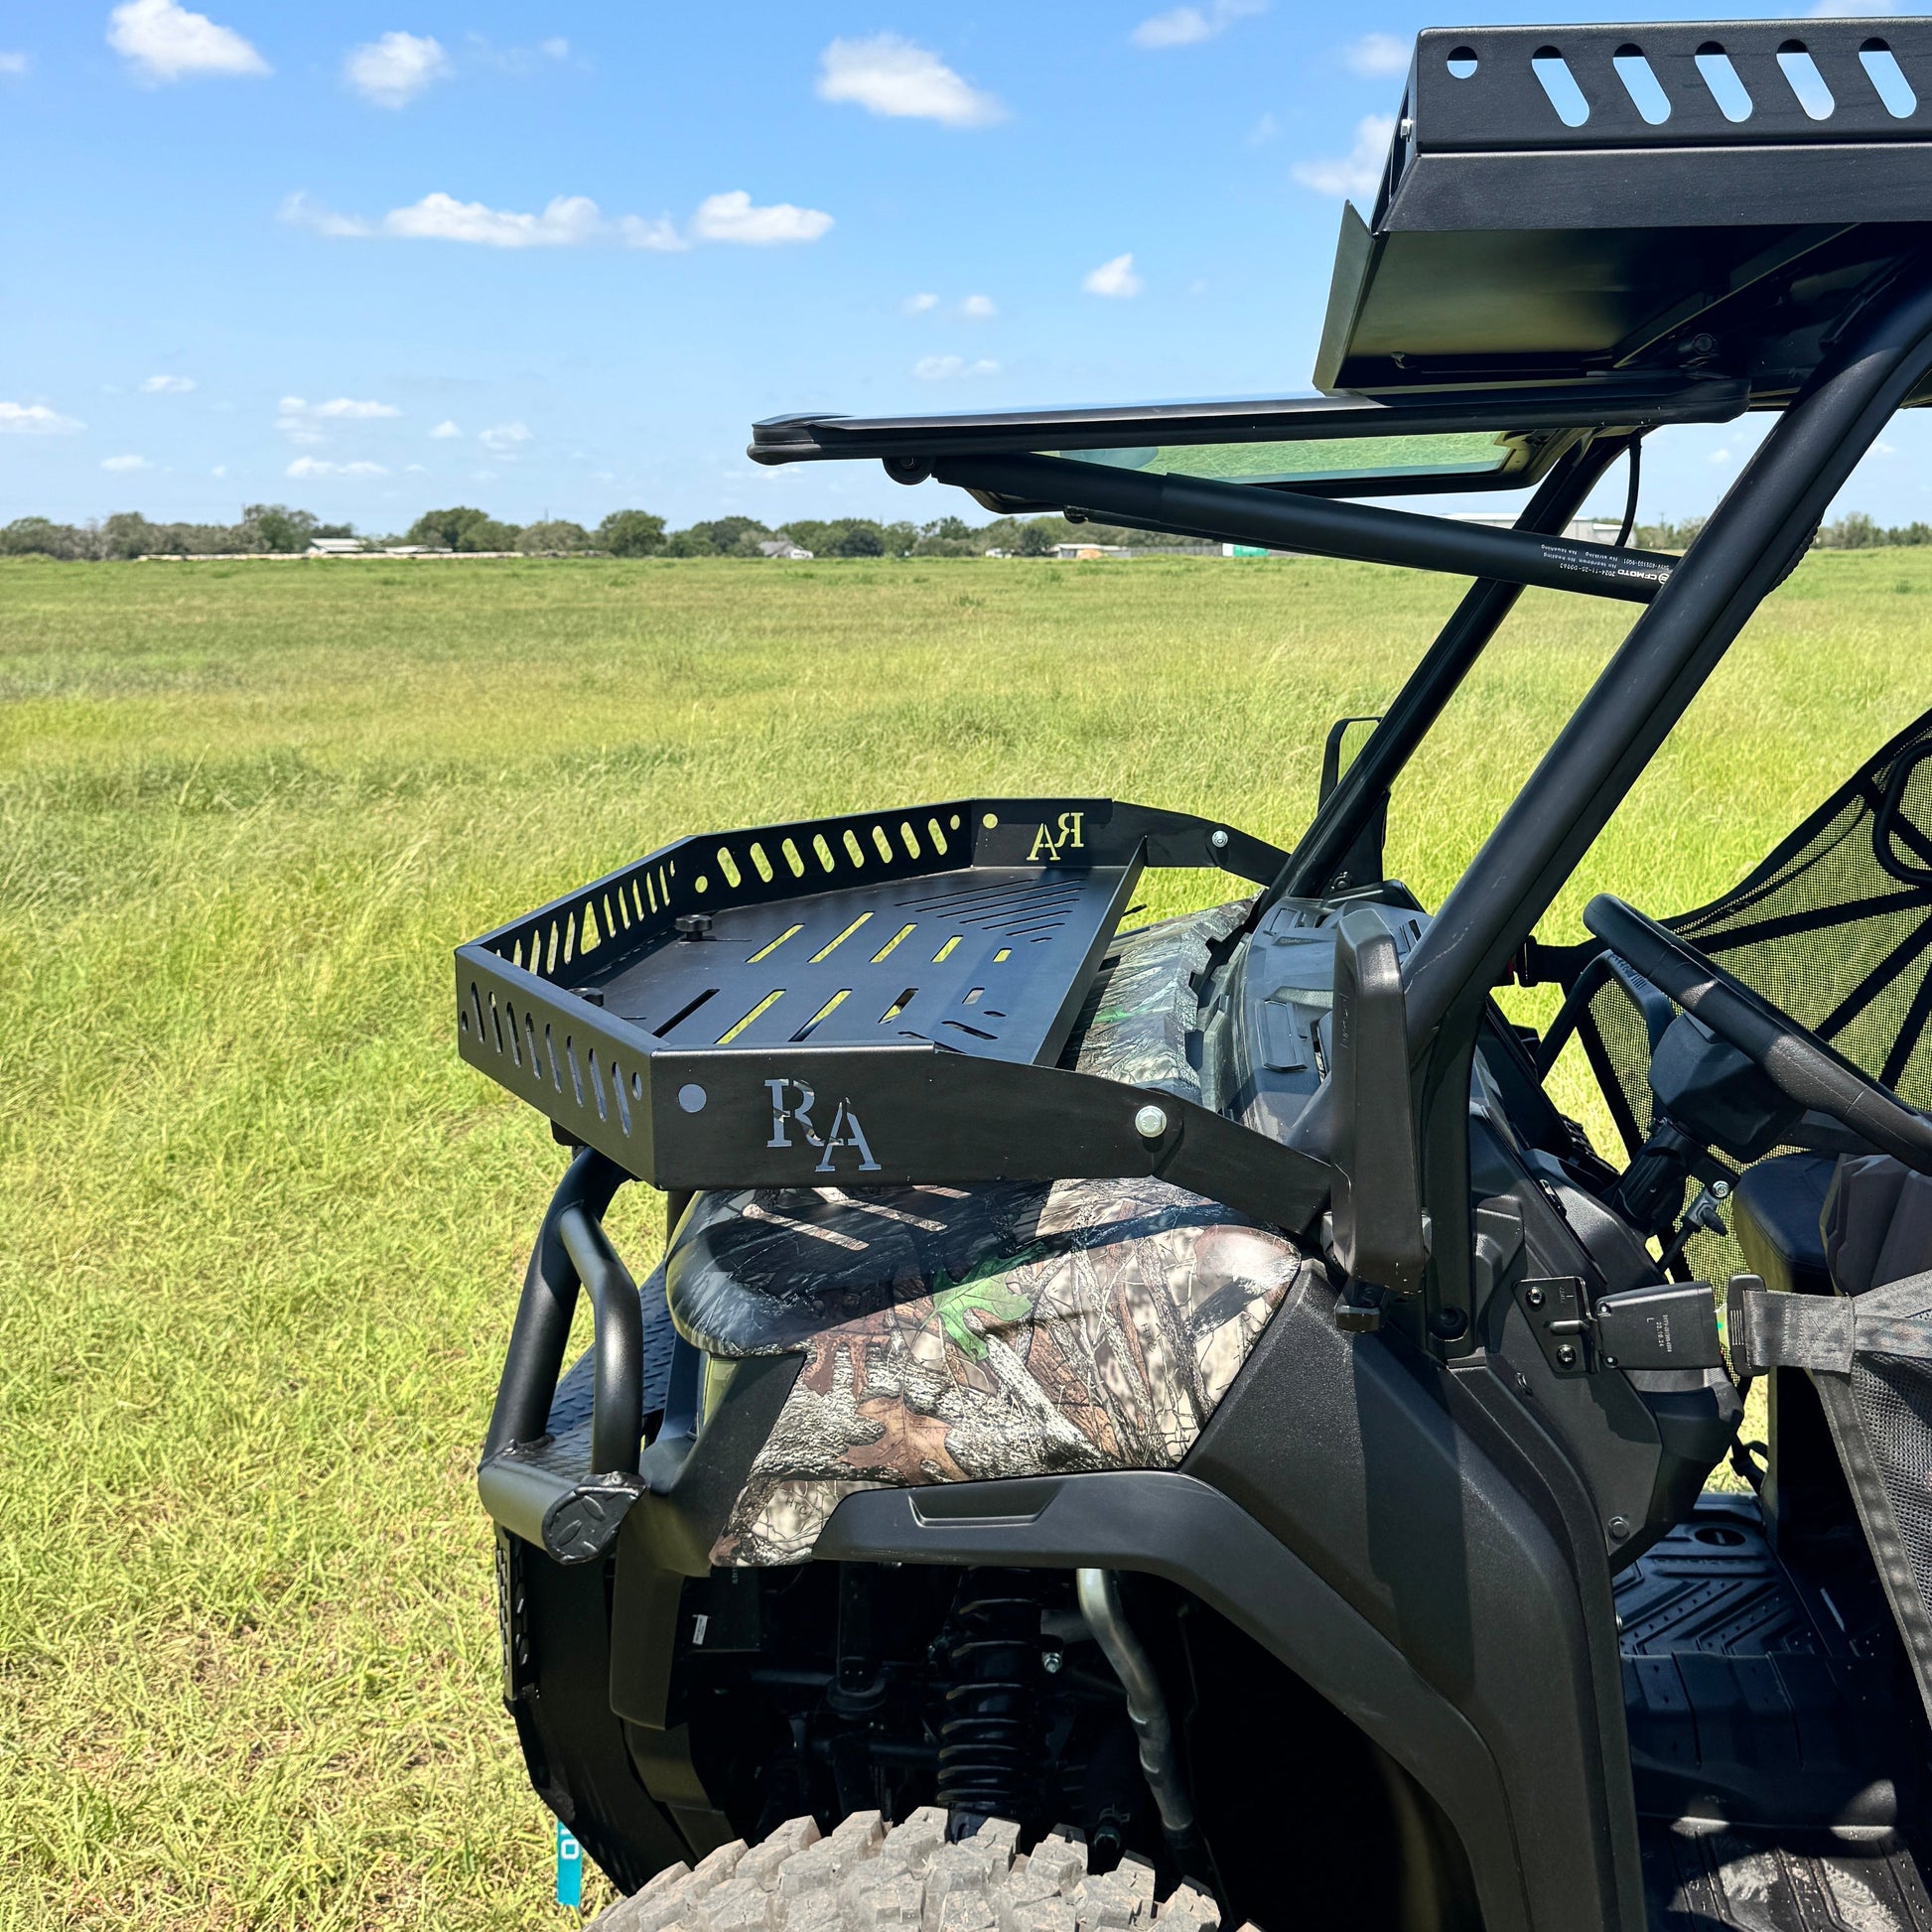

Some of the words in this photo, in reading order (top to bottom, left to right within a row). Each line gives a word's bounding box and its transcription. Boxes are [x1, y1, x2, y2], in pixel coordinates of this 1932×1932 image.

[1617, 568, 1657, 581] CFMOTO
[763, 1078, 882, 1173] RA
[785, 1496, 807, 1515] HTC
